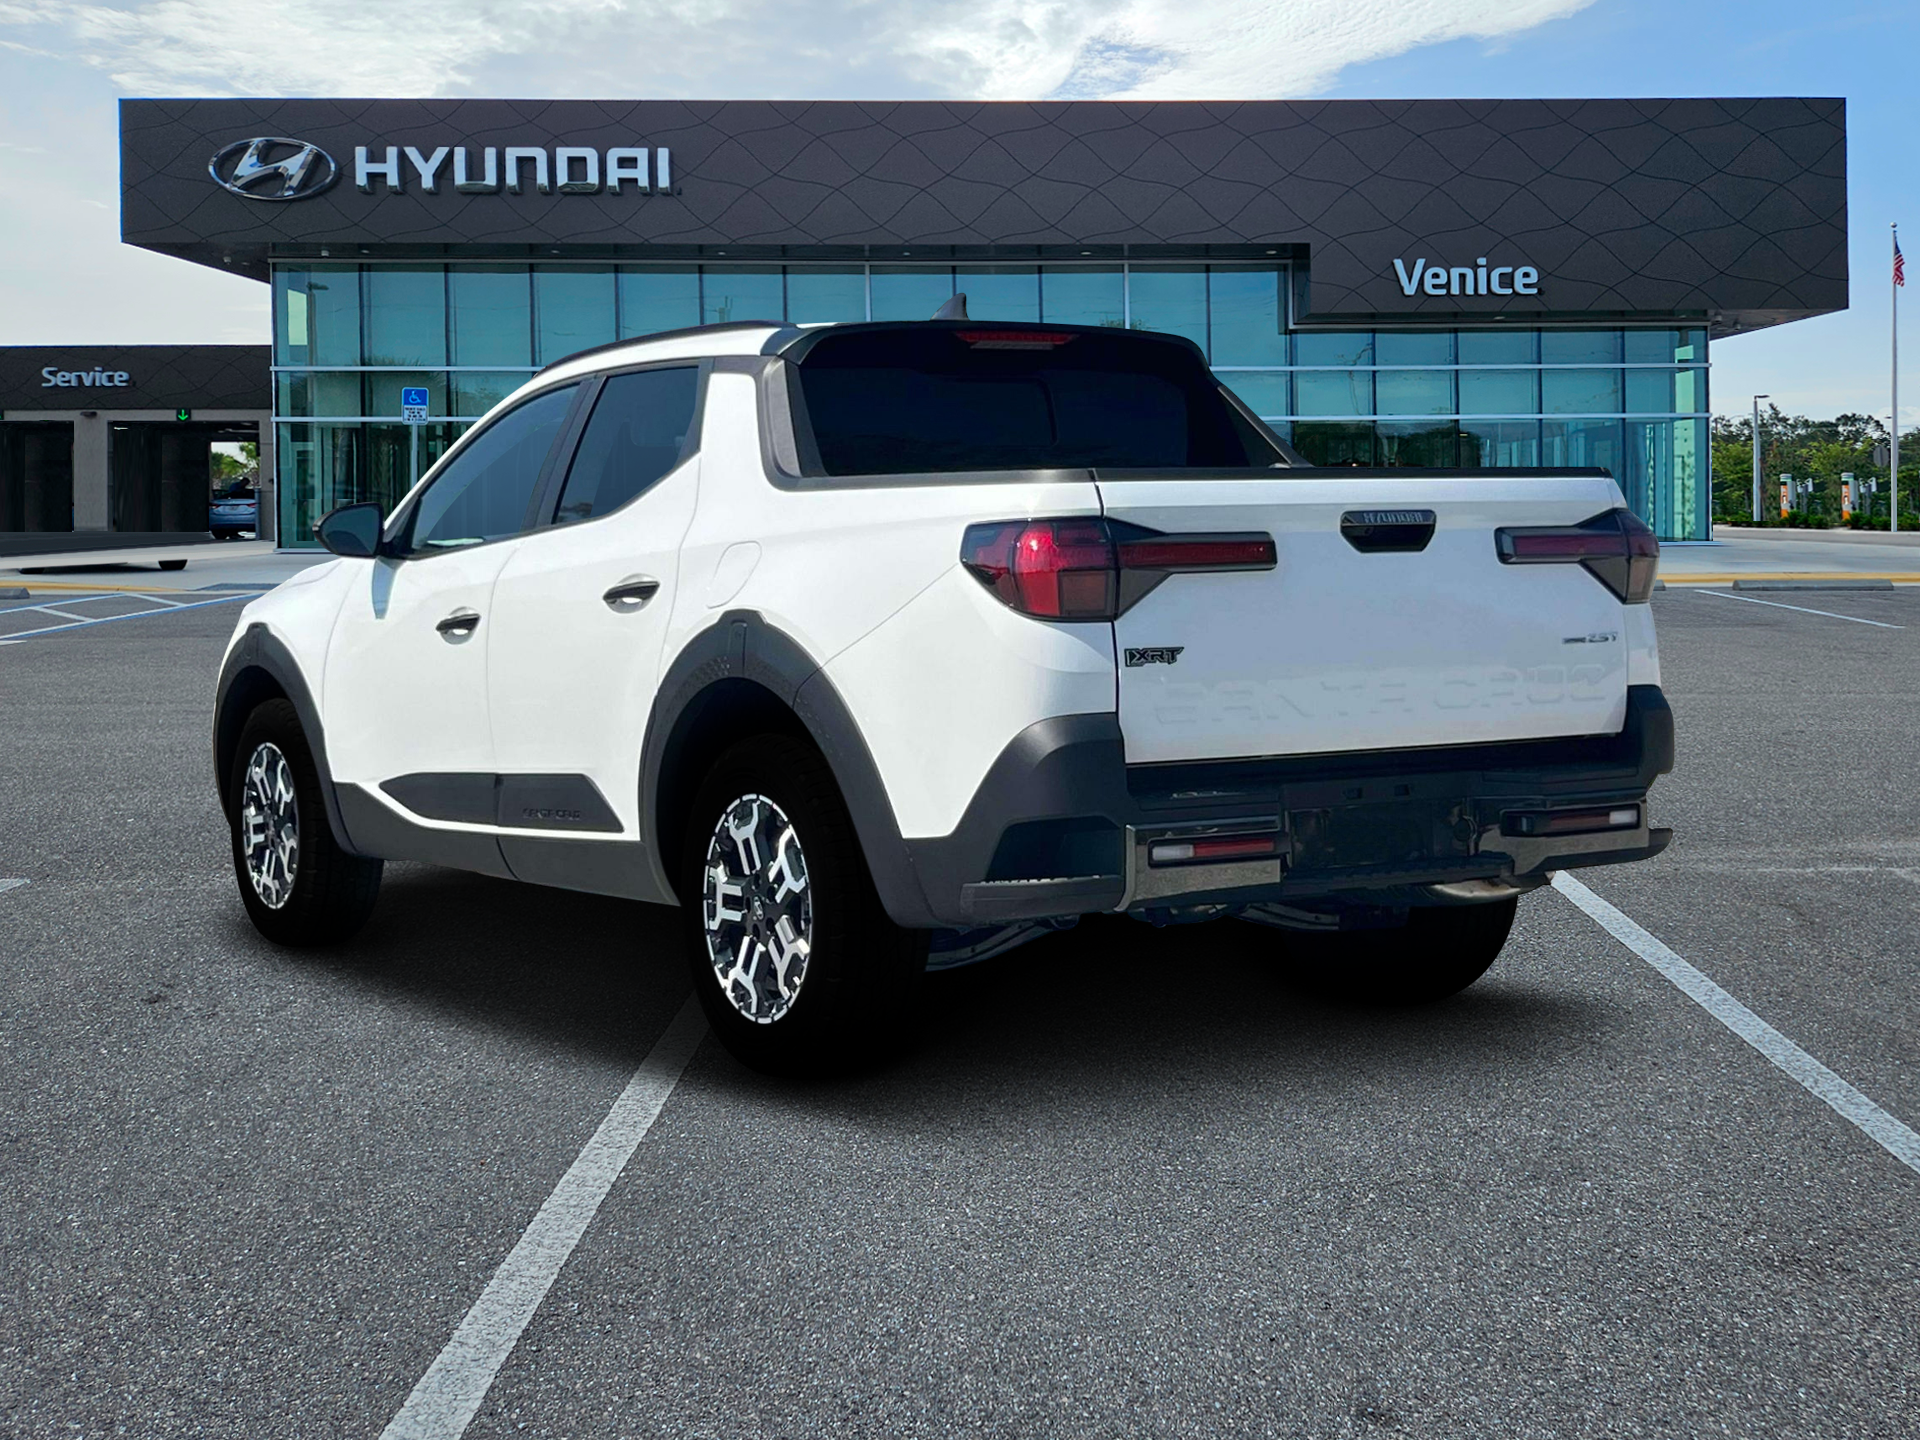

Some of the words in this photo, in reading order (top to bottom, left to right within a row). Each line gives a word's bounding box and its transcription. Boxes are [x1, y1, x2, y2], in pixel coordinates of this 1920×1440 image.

[355, 146, 670, 194] HYUNDAI
[1393, 257, 1540, 296] Venice
[41, 366, 130, 387] Service
[1124, 647, 1184, 667] XRT
